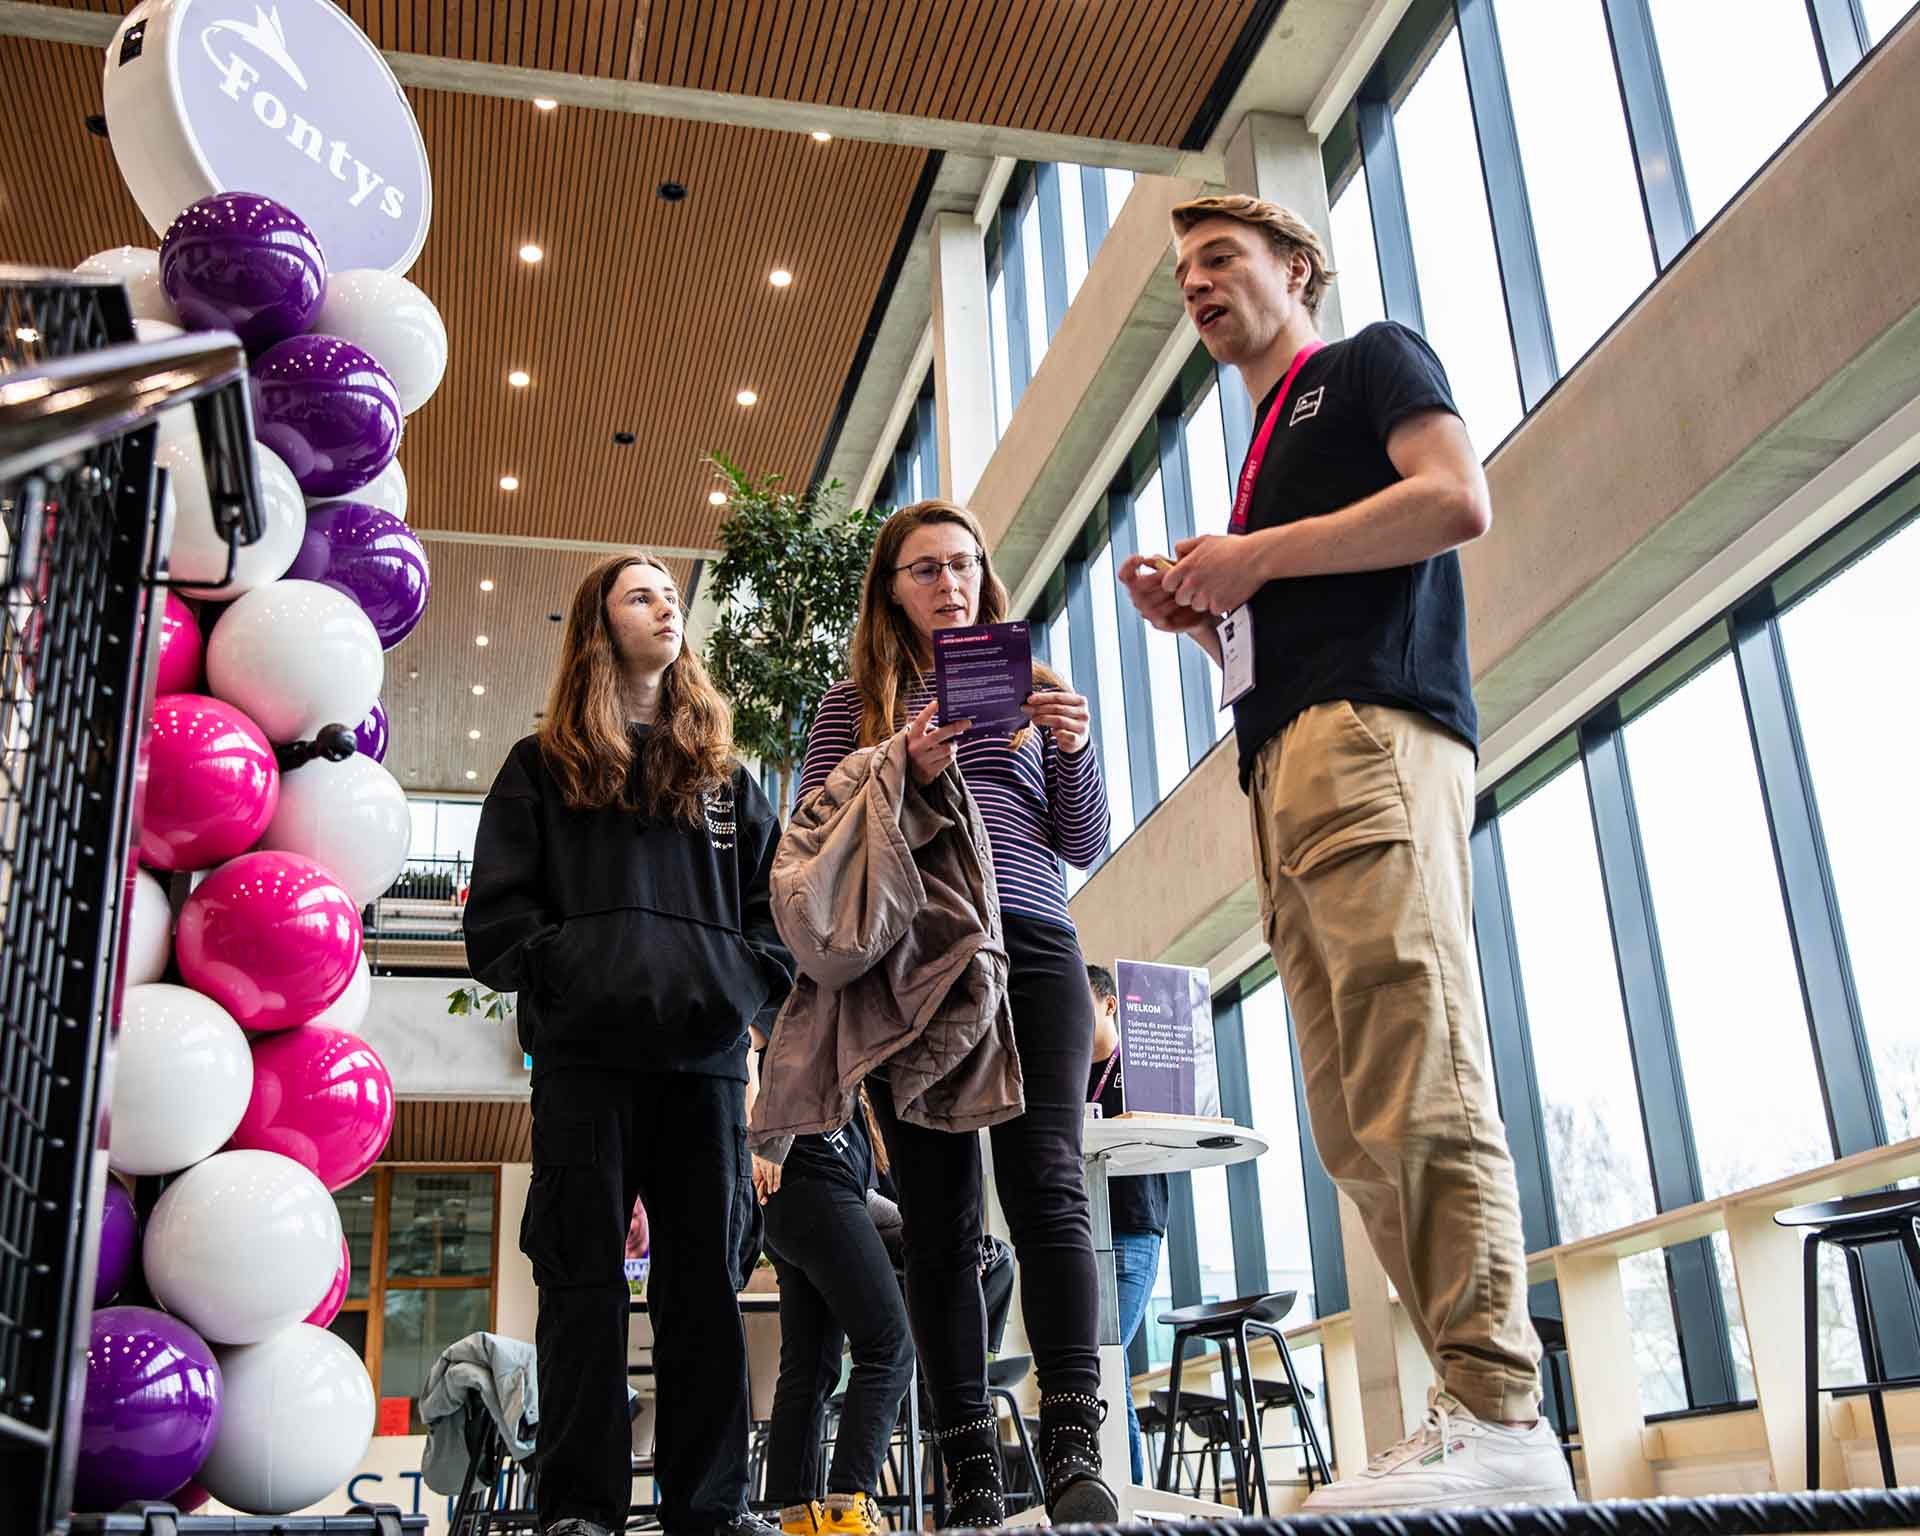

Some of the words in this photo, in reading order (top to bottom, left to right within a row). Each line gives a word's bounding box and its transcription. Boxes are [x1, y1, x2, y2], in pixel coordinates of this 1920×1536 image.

[219, 52, 405, 219] Fontys
[1126, 1002, 1160, 1014] WELKOM
[1128, 1019, 1148, 1029] Tijdens
[1128, 1027, 1150, 1036] beelden
